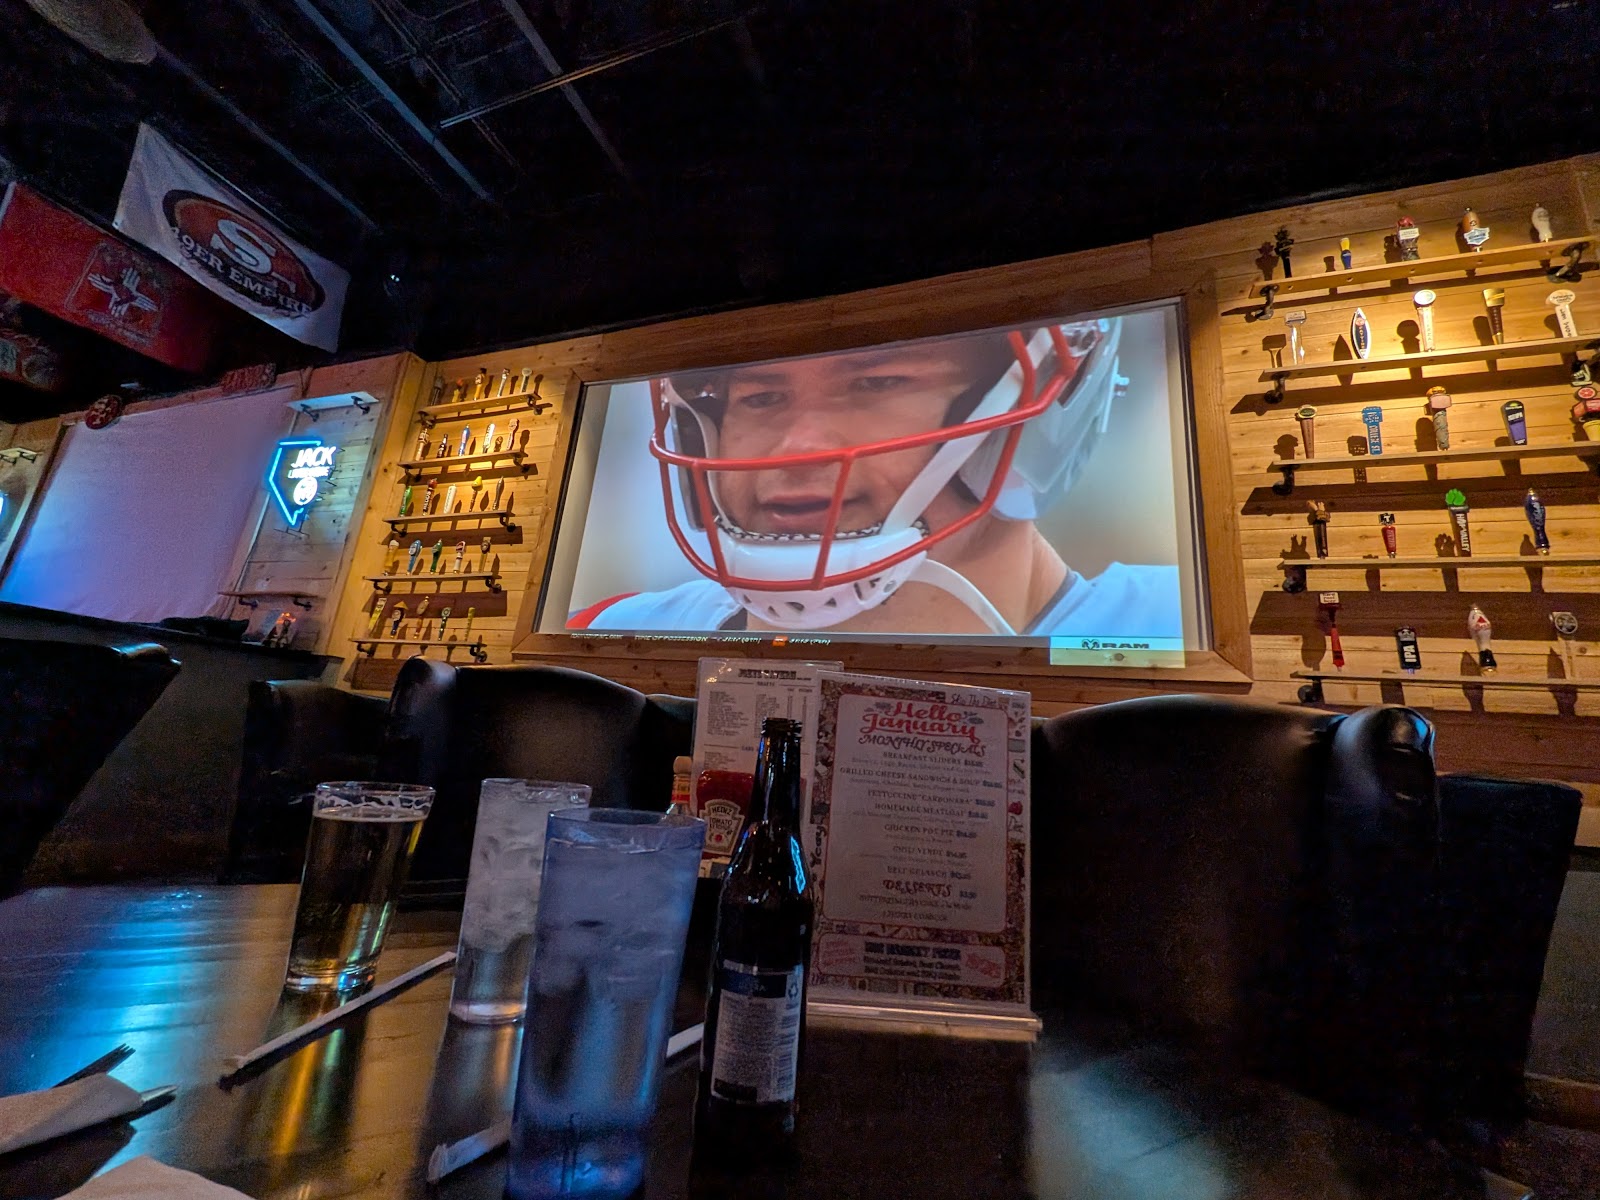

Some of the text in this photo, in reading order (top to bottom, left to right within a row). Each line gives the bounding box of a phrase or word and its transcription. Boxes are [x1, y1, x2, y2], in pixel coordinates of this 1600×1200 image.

[229, 271, 312, 315] EMPIRE
[290, 446, 336, 468] JACK
[1403, 645, 1418, 663] IPA
[884, 702, 962, 722] Hello
[860, 712, 981, 744] January
[858, 734, 986, 757] MONTHLY SPECIALS
[882, 751, 927, 761] BREAKFAST
[929, 755, 961, 766] SLIDERS
[840, 766, 874, 776] GRILLED
[875, 770, 906, 779] CHEESE
[908, 773, 951, 784] SANDWICH
[959, 777, 980, 786] SOUP
[868, 789, 917, 800] FETTUCCINE
[712, 806, 733, 816] HEINZ
[875, 803, 922, 813] HOMEMADE
[923, 807, 965, 817] MEATLOAF
[884, 823, 921, 833] CHICKEN
[923, 826, 938, 834] POT
[940, 828, 955, 837] PIE
[883, 879, 953, 898] DESSERTS
